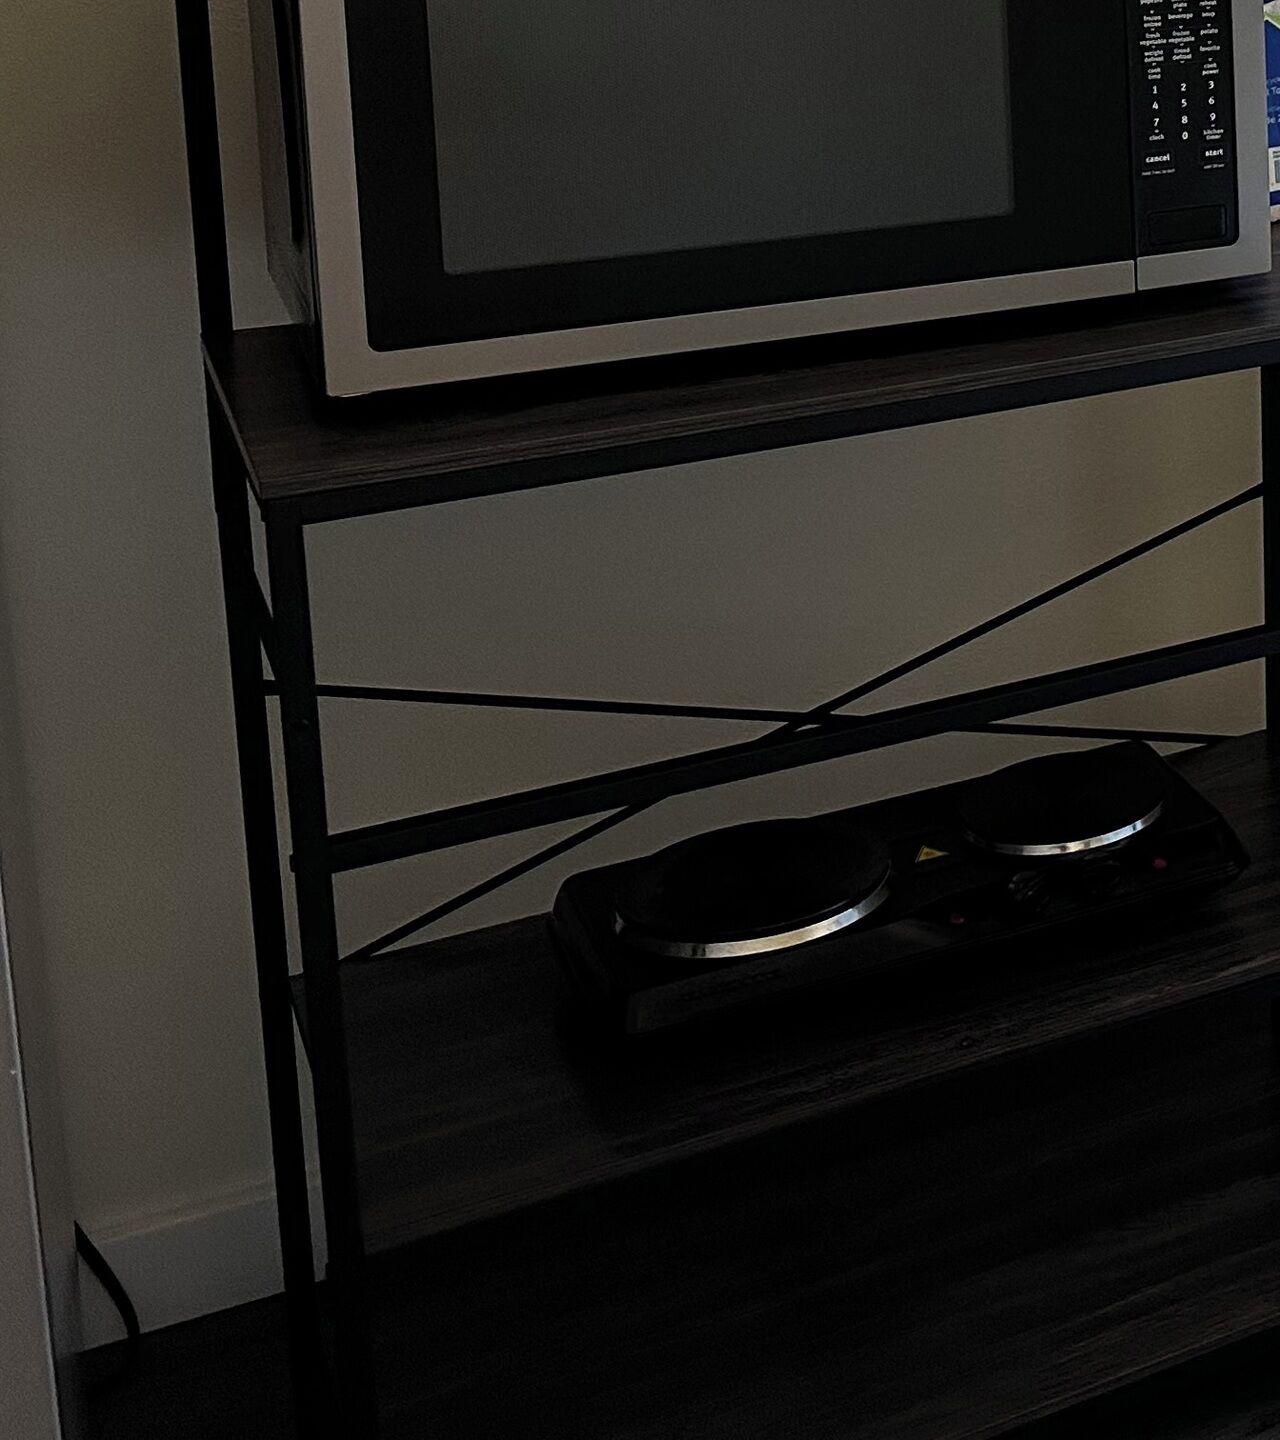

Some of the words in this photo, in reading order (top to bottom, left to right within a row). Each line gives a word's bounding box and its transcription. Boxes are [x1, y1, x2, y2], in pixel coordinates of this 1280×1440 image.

[1180, 82, 1187, 92] 2
[1208, 80, 1215, 89] 3
[1152, 85, 1158, 94] 1
[1152, 101, 1159, 109] 4
[1181, 98, 1187, 108] 5
[1208, 96, 1215, 105] 6
[1181, 115, 1188, 124] 8
[1209, 112, 1216, 121] 9
[1153, 118, 1160, 127] 7
[1182, 131, 1188, 140] 0
[1205, 148, 1224, 157] start
[1145, 153, 1170, 163] cancel
